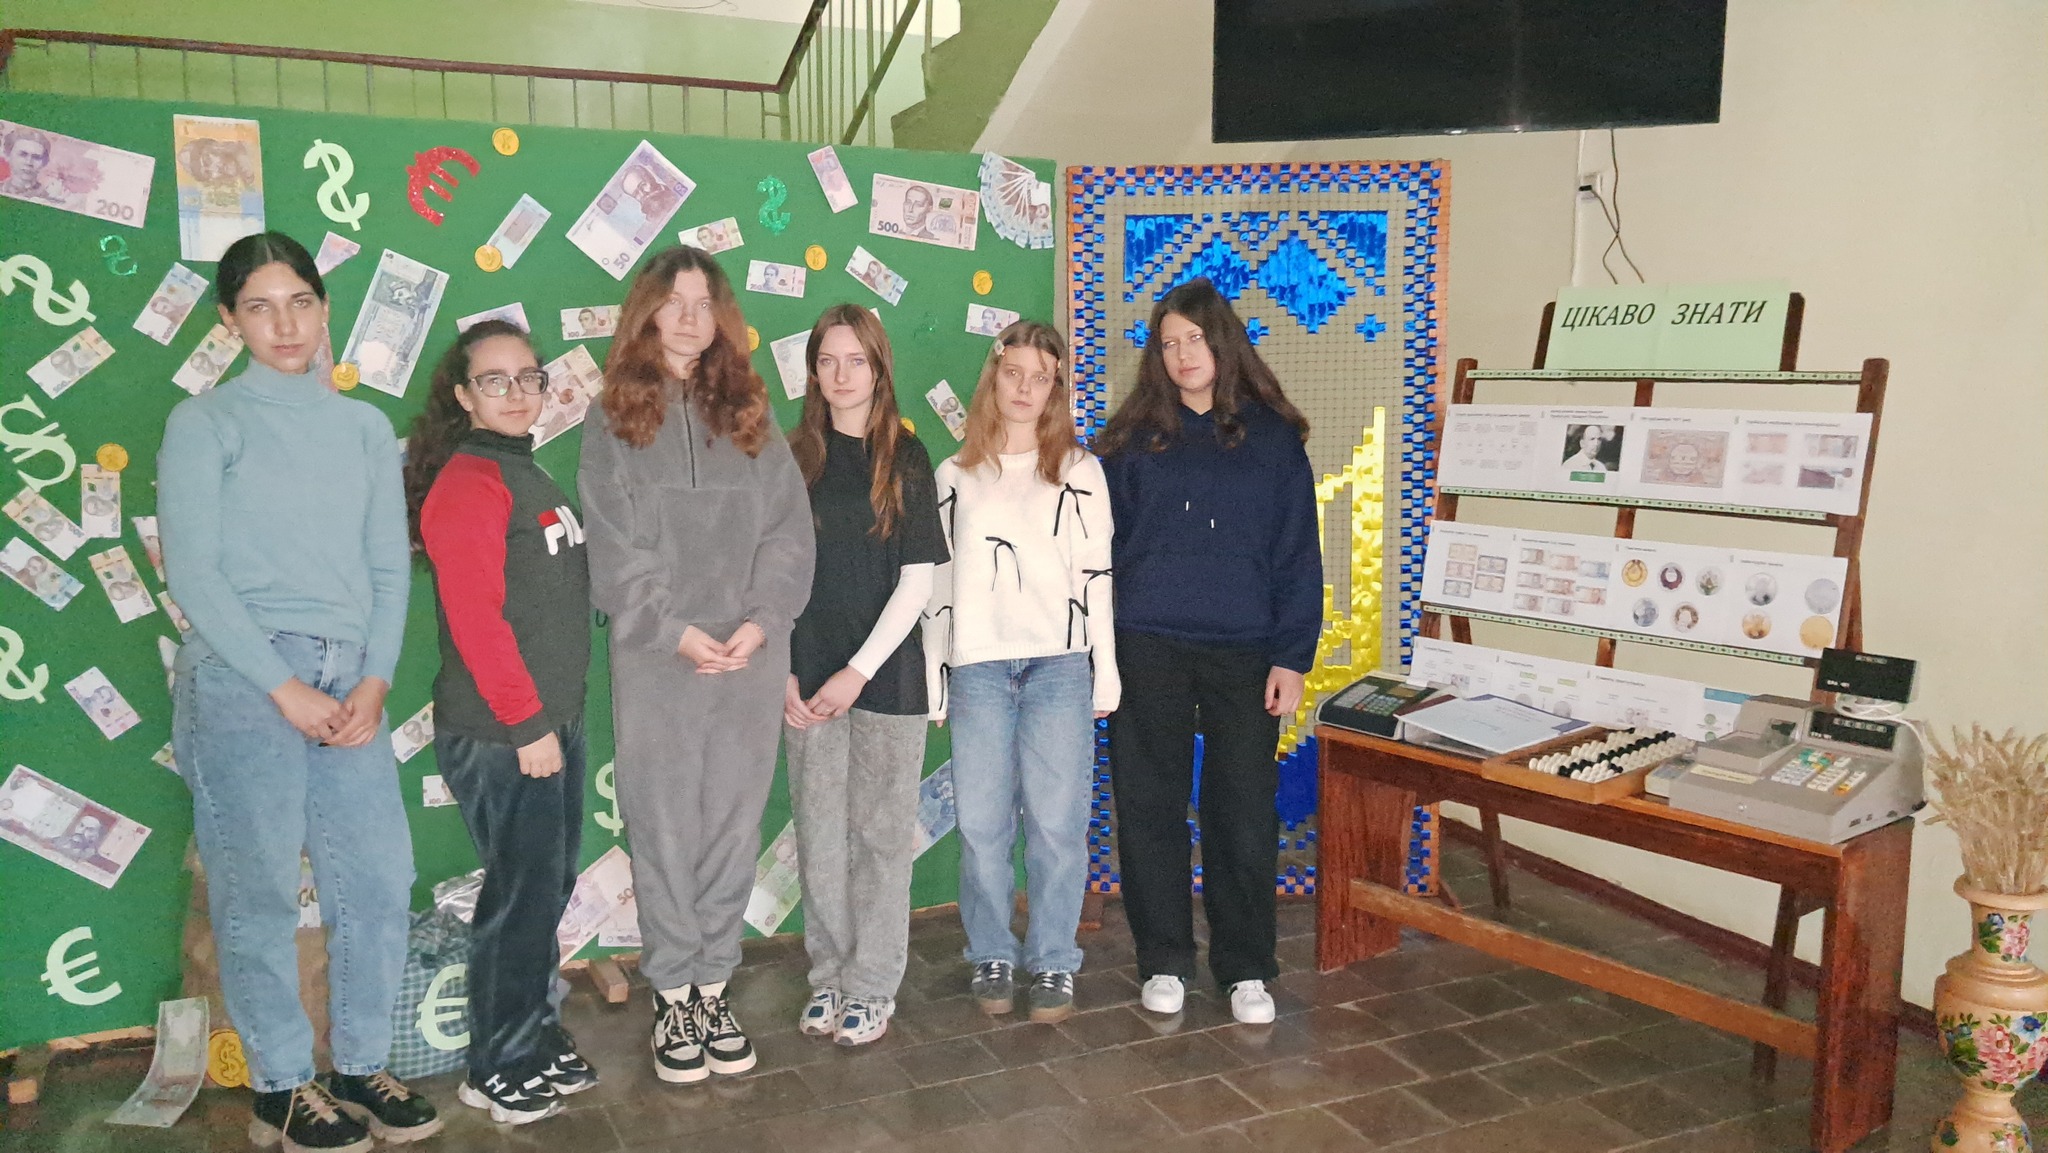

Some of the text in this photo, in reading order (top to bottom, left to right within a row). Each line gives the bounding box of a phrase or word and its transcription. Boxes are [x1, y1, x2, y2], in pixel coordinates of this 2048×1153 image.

[96, 199, 135, 221] 200
[877, 220, 900, 234] 500
[613, 251, 631, 270] 50
[1560, 300, 1768, 331] ЦІКАВО ЗНАТИ
[616, 887, 634, 905] 50
